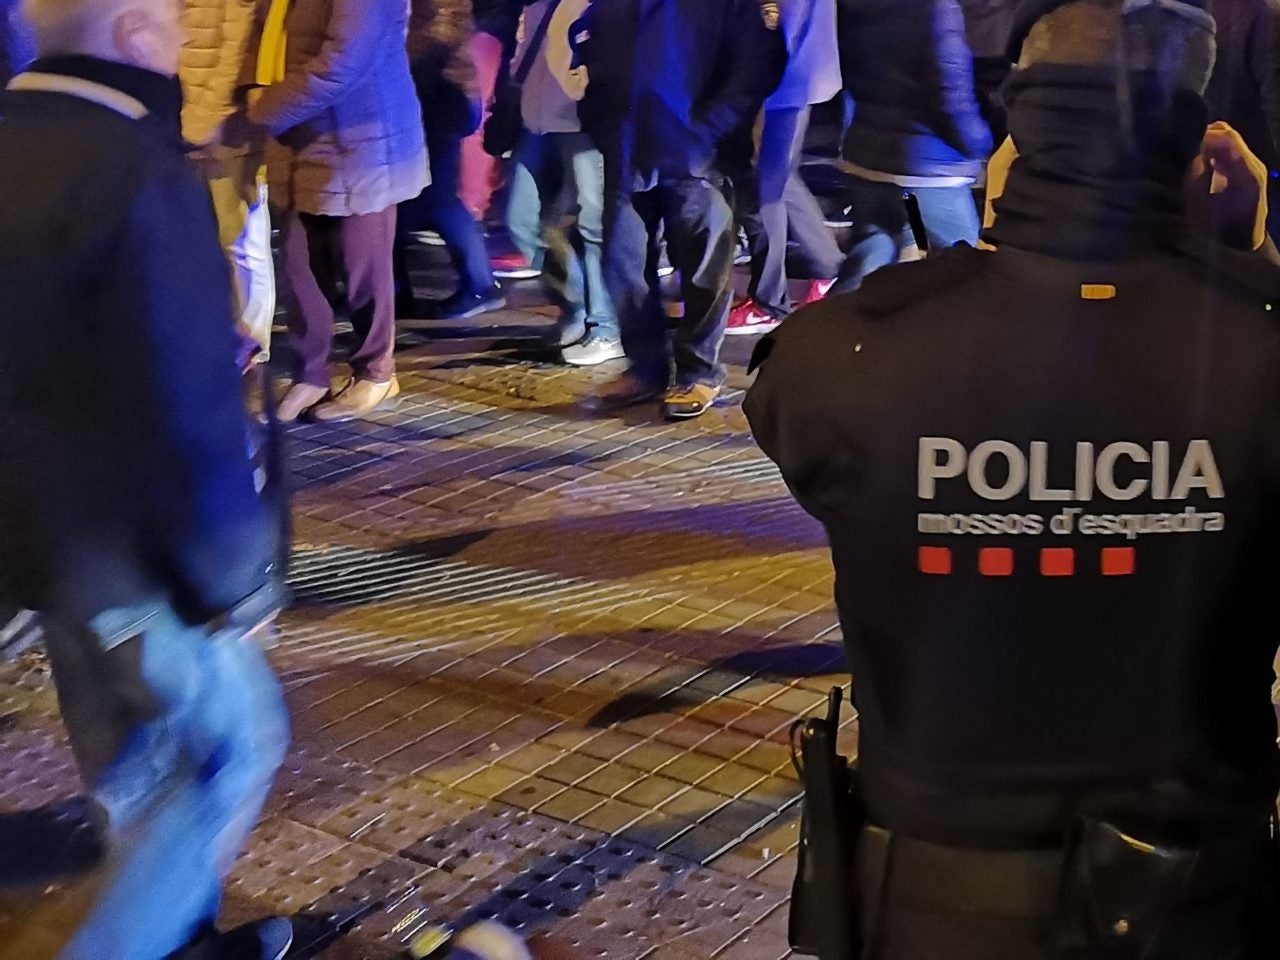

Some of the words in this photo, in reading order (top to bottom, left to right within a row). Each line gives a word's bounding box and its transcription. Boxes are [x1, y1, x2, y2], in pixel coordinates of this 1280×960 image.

[917, 437, 1225, 501] POLICIA
[917, 513, 1044, 535] mossos
[1050, 506, 1225, 540] d'esquadra
